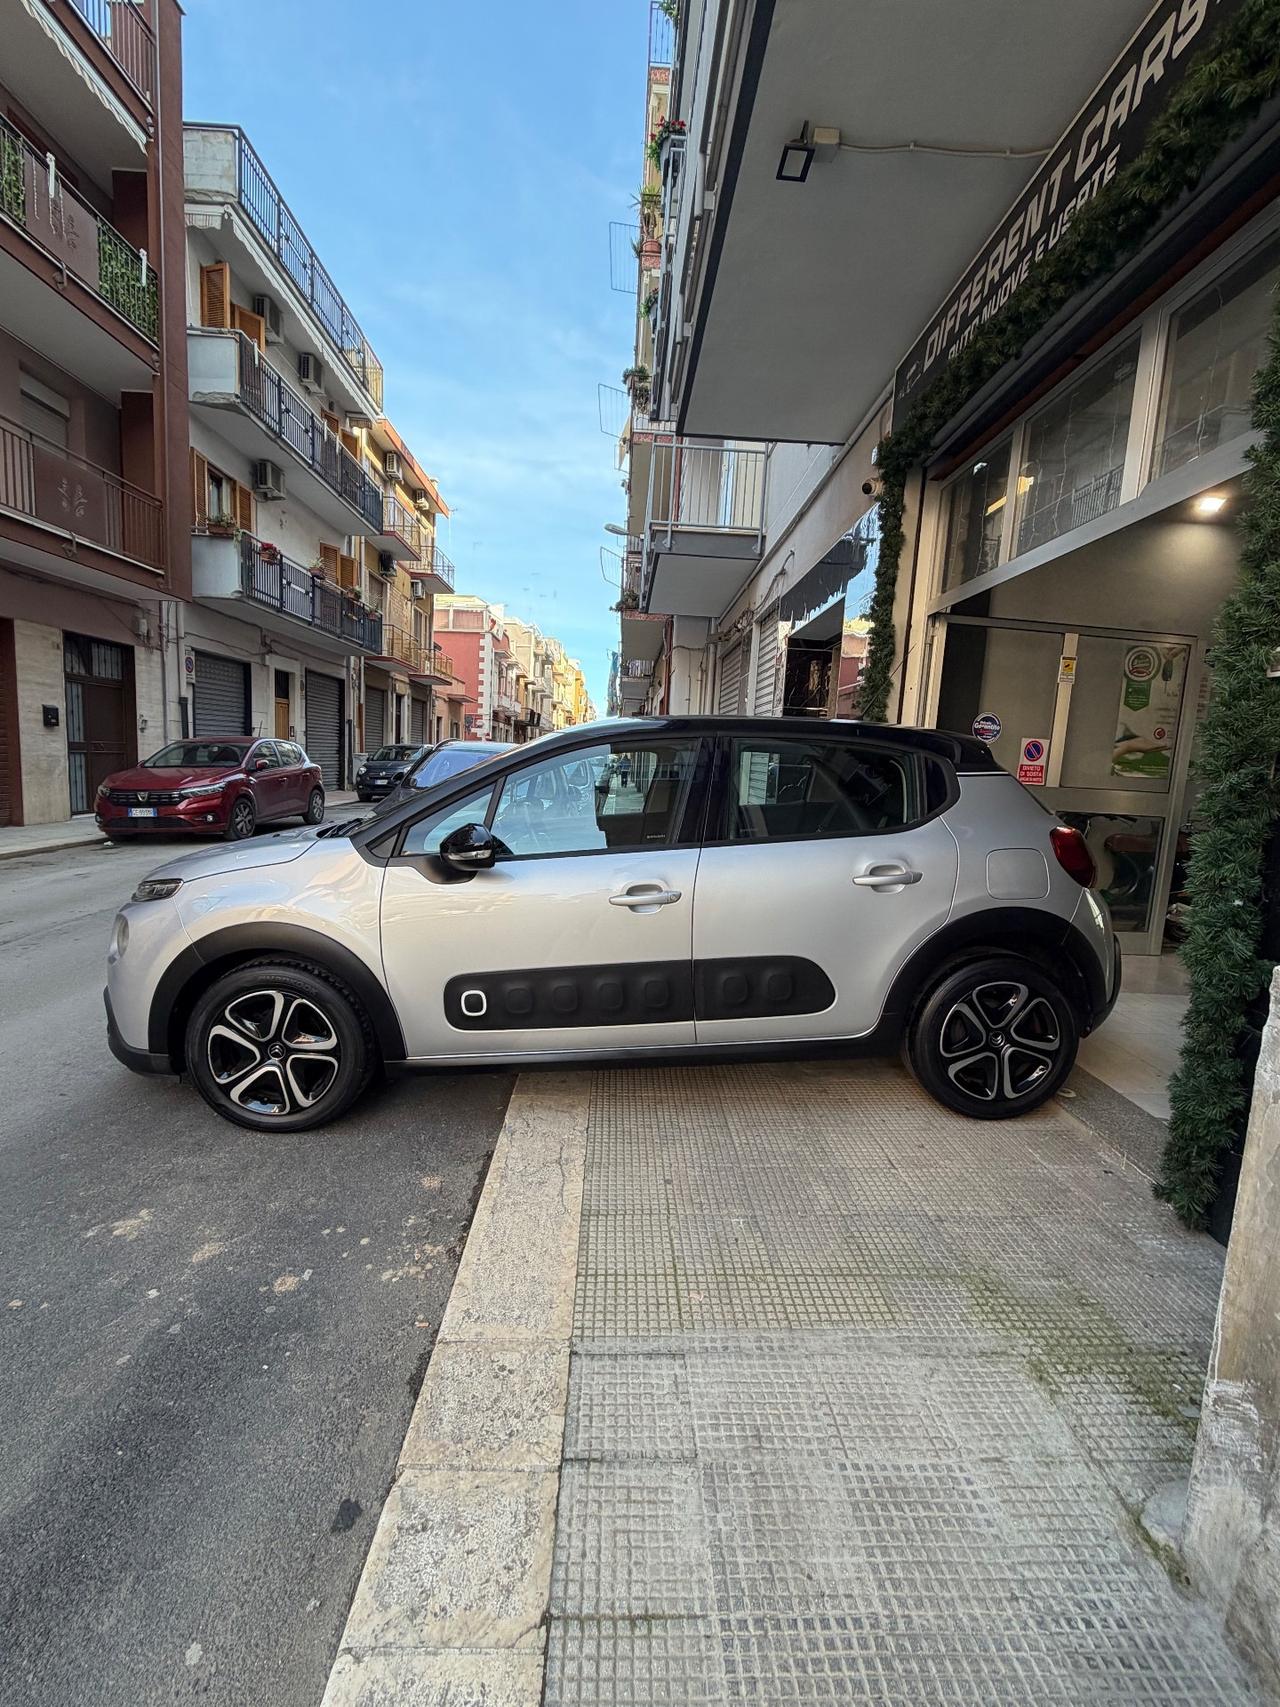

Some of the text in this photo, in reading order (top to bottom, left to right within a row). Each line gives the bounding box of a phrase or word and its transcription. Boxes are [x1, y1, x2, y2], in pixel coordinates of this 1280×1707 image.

[923, 150, 1072, 374] DIFFERENT
[981, 250, 1033, 324] NUOVE
[1035, 232, 1048, 263] E
[1048, 143, 1121, 250] USATE
